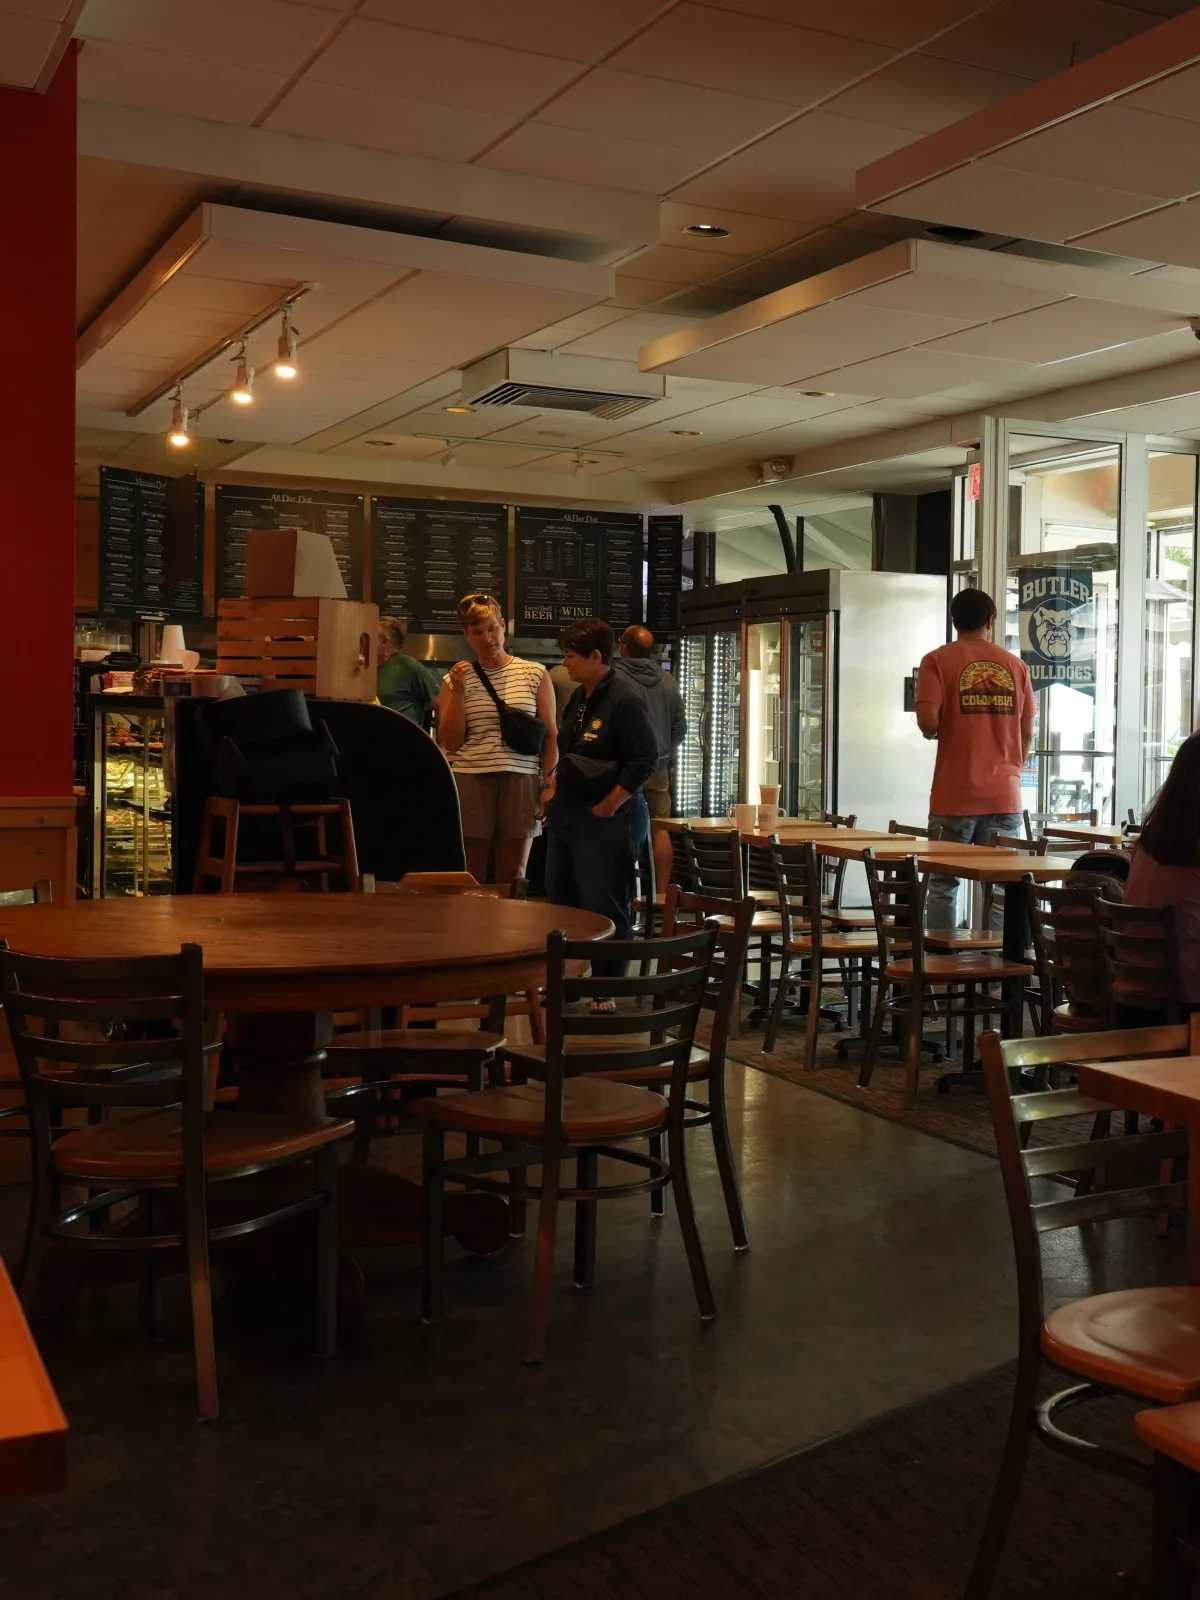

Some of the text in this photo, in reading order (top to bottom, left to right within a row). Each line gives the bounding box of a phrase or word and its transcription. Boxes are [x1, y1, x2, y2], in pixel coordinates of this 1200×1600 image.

[1022, 576, 1090, 603] BUTLER
[524, 611, 553, 620] BEER
[562, 606, 592, 616] WINE
[1028, 664, 1092, 680] ULLDOGS
[962, 694, 1013, 706] COLOMBIA
